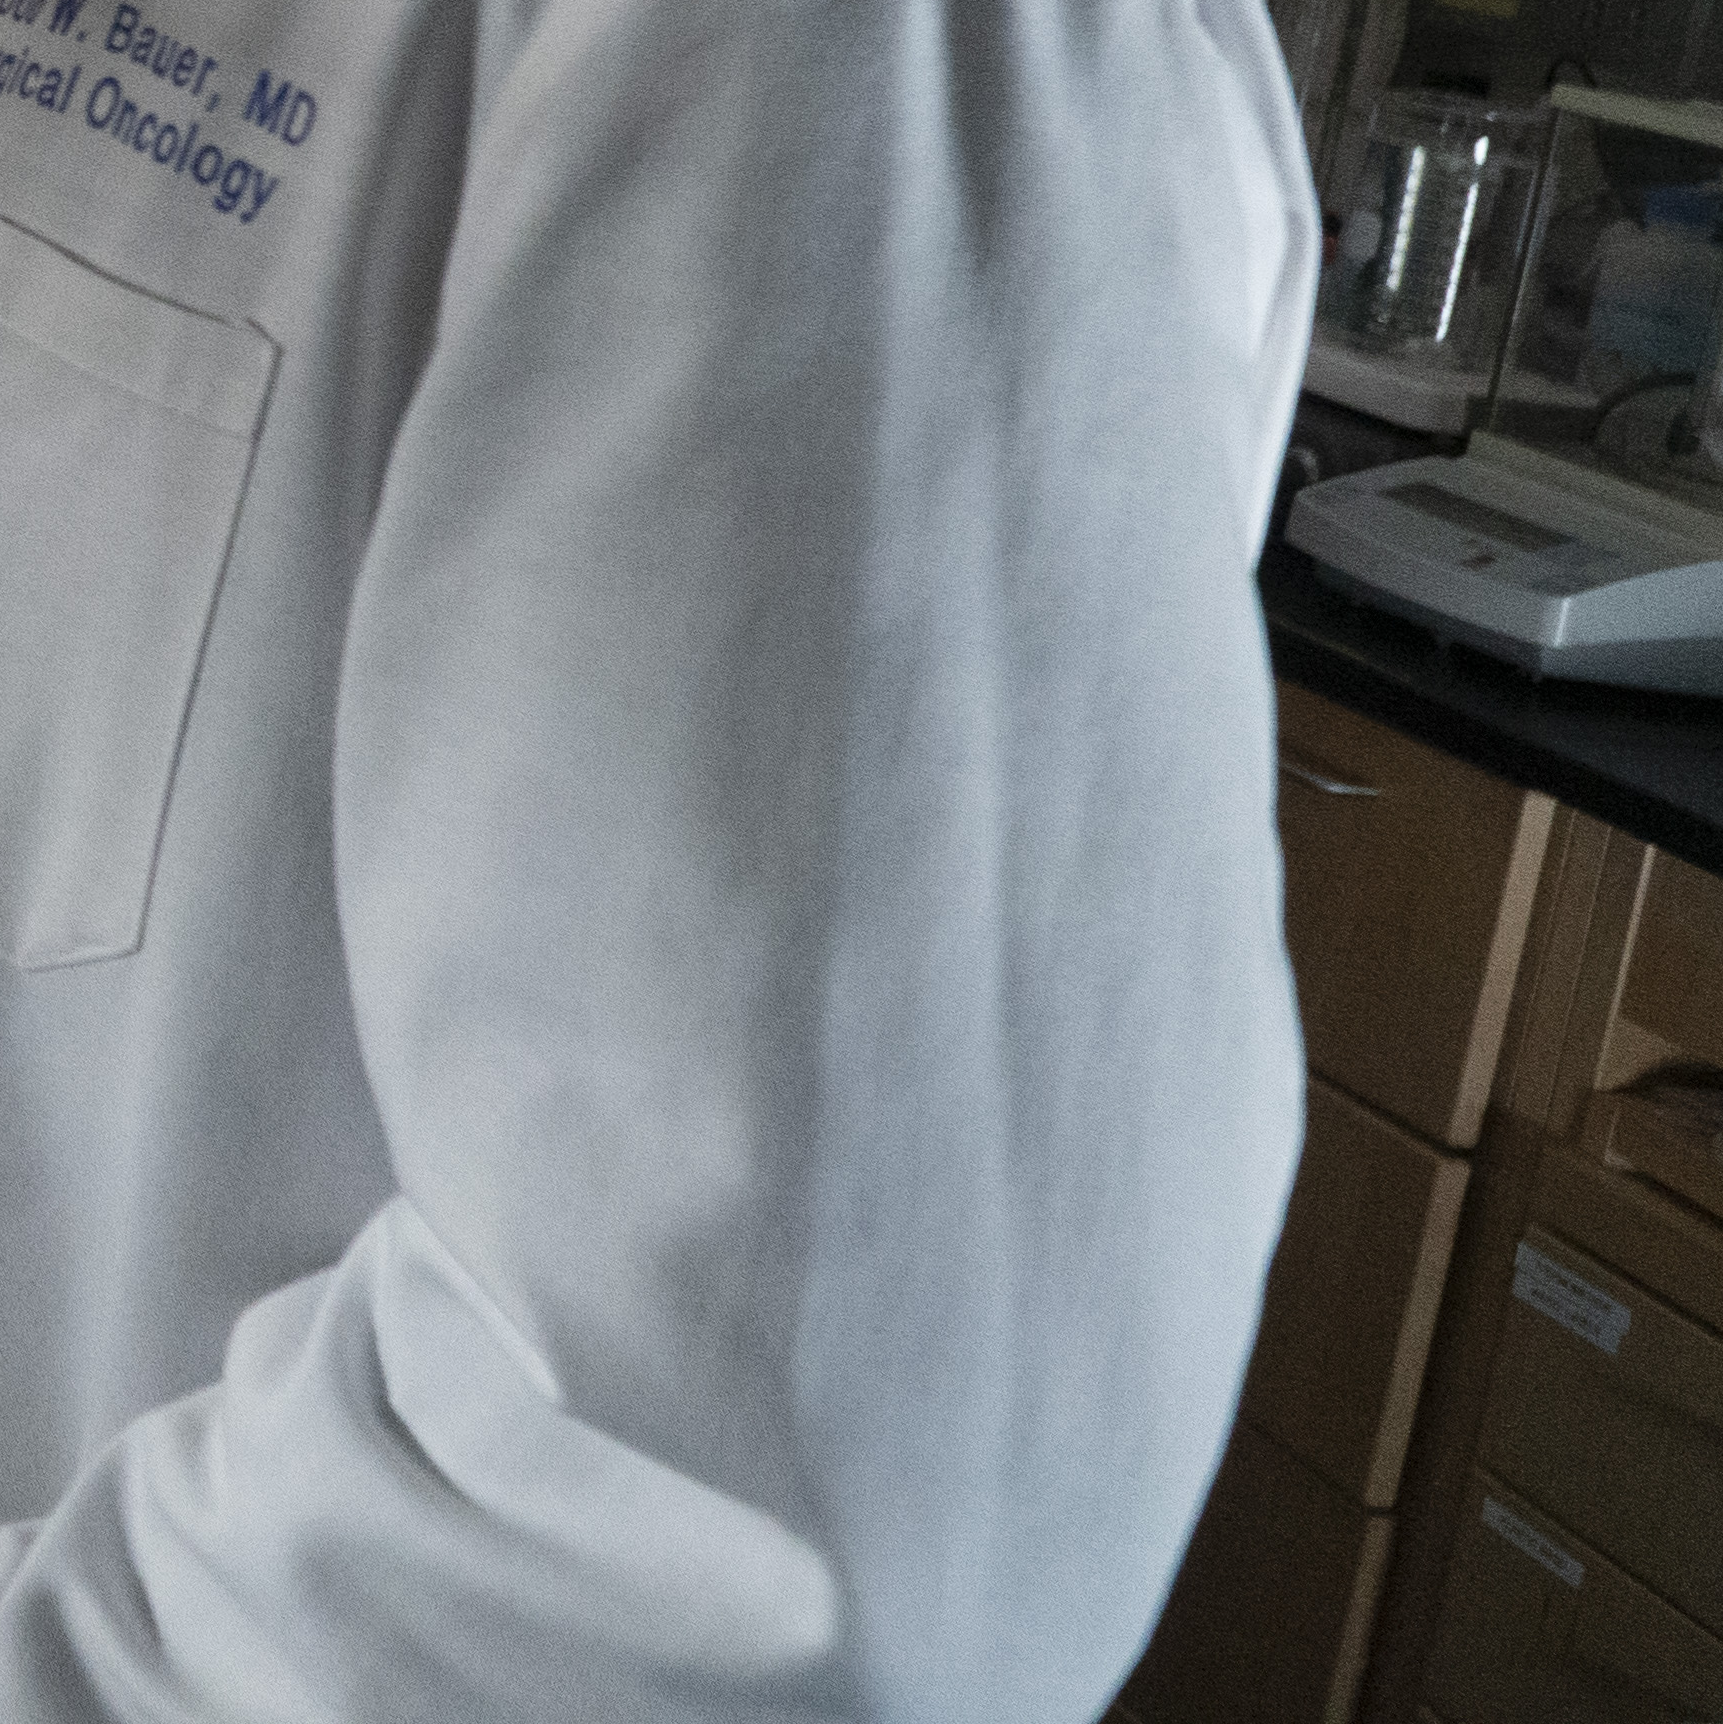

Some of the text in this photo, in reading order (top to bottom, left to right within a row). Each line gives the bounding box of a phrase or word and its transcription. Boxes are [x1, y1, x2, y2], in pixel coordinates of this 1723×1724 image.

[104, 2, 221, 113] Bauer,
[244, 68, 318, 147] MD
[85, 76, 279, 225] Oncology
